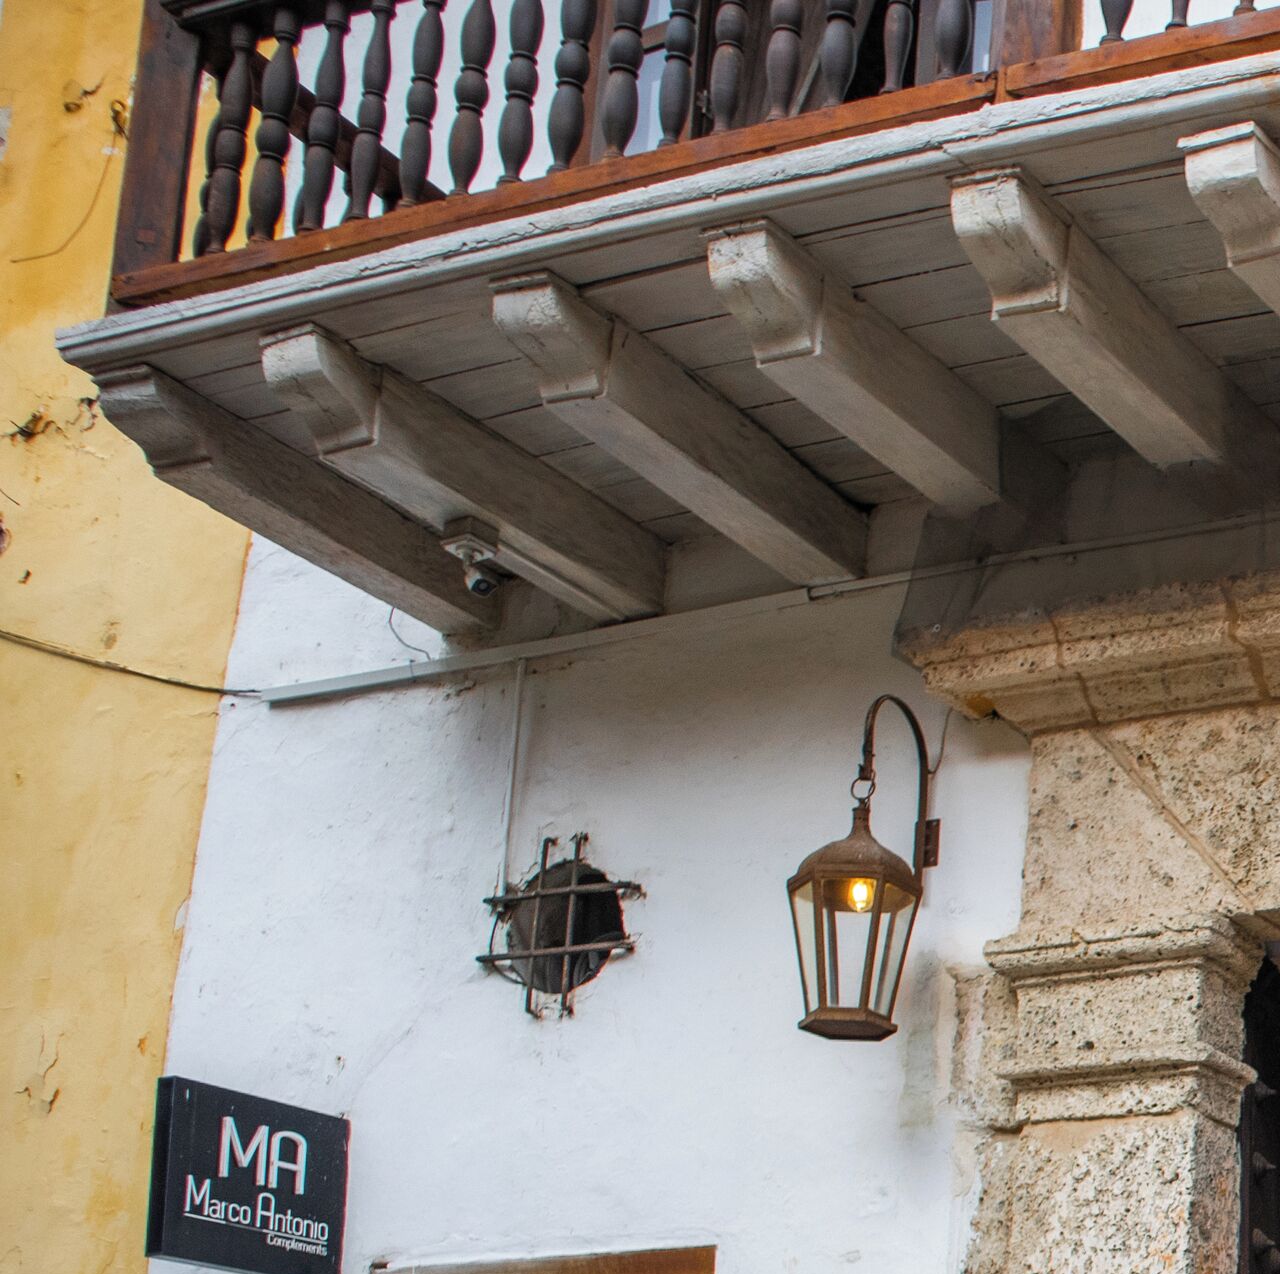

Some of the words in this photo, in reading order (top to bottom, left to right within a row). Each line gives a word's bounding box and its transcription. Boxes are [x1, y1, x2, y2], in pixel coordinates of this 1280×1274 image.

[219, 1116, 306, 1194] MA
[184, 1175, 250, 1223] Marco
[256, 1193, 328, 1240] Antonio
[267, 1233, 327, 1256] Complements
